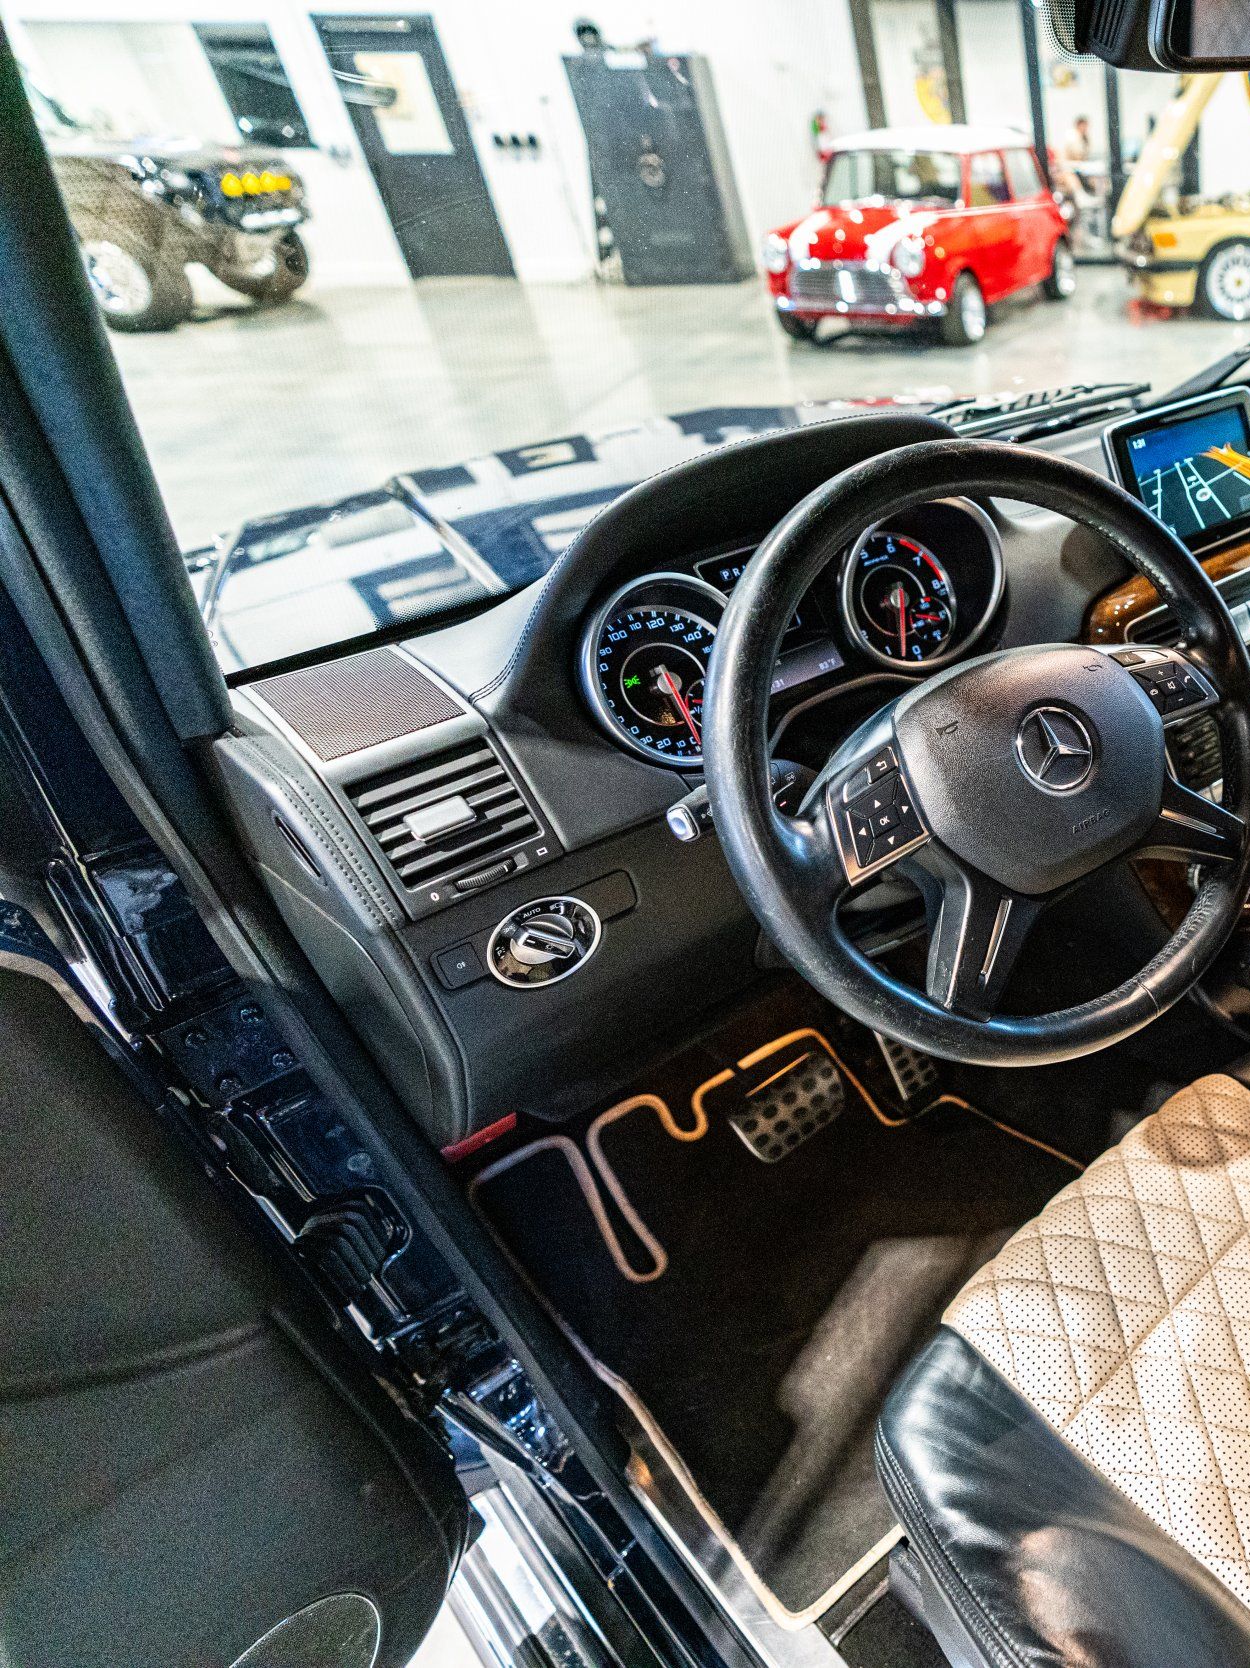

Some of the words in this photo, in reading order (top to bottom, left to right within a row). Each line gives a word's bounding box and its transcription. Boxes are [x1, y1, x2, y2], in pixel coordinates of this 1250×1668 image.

[886, 543, 896, 554] 6
[912, 556, 921, 567] 7
[629, 621, 642, 631] 110
[646, 617, 665, 630] 120
[669, 622, 685, 633] 130
[608, 629, 628, 643] 100
[683, 630, 702, 643] 140
[656, 737, 672, 750] 20
[676, 739, 687, 749] 10
[880, 815, 891, 826] OK
[523, 907, 542, 919] AUTO
